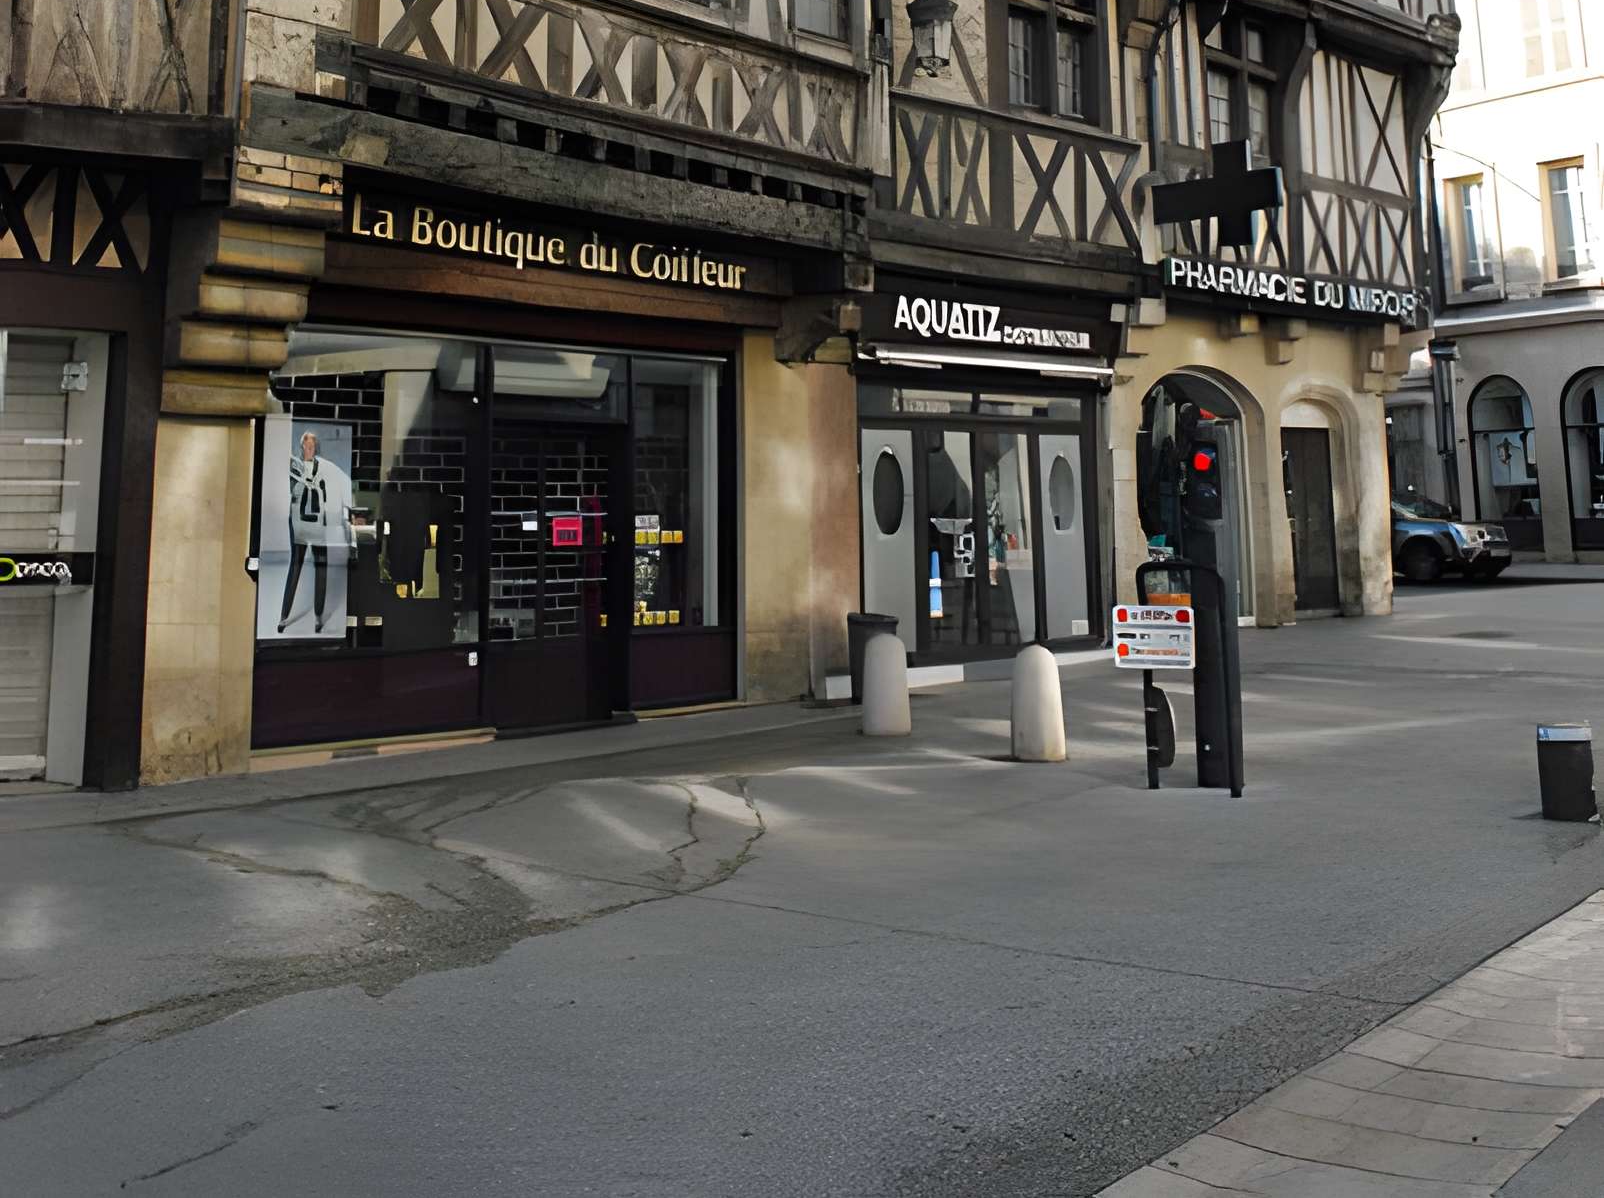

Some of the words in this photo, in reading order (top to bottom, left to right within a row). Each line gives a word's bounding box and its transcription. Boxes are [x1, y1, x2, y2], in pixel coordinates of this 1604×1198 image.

[352, 193, 394, 240] La
[579, 230, 618, 273] du
[1170, 257, 1307, 305] PHARMACIE
[1314, 280, 1345, 310] DU
